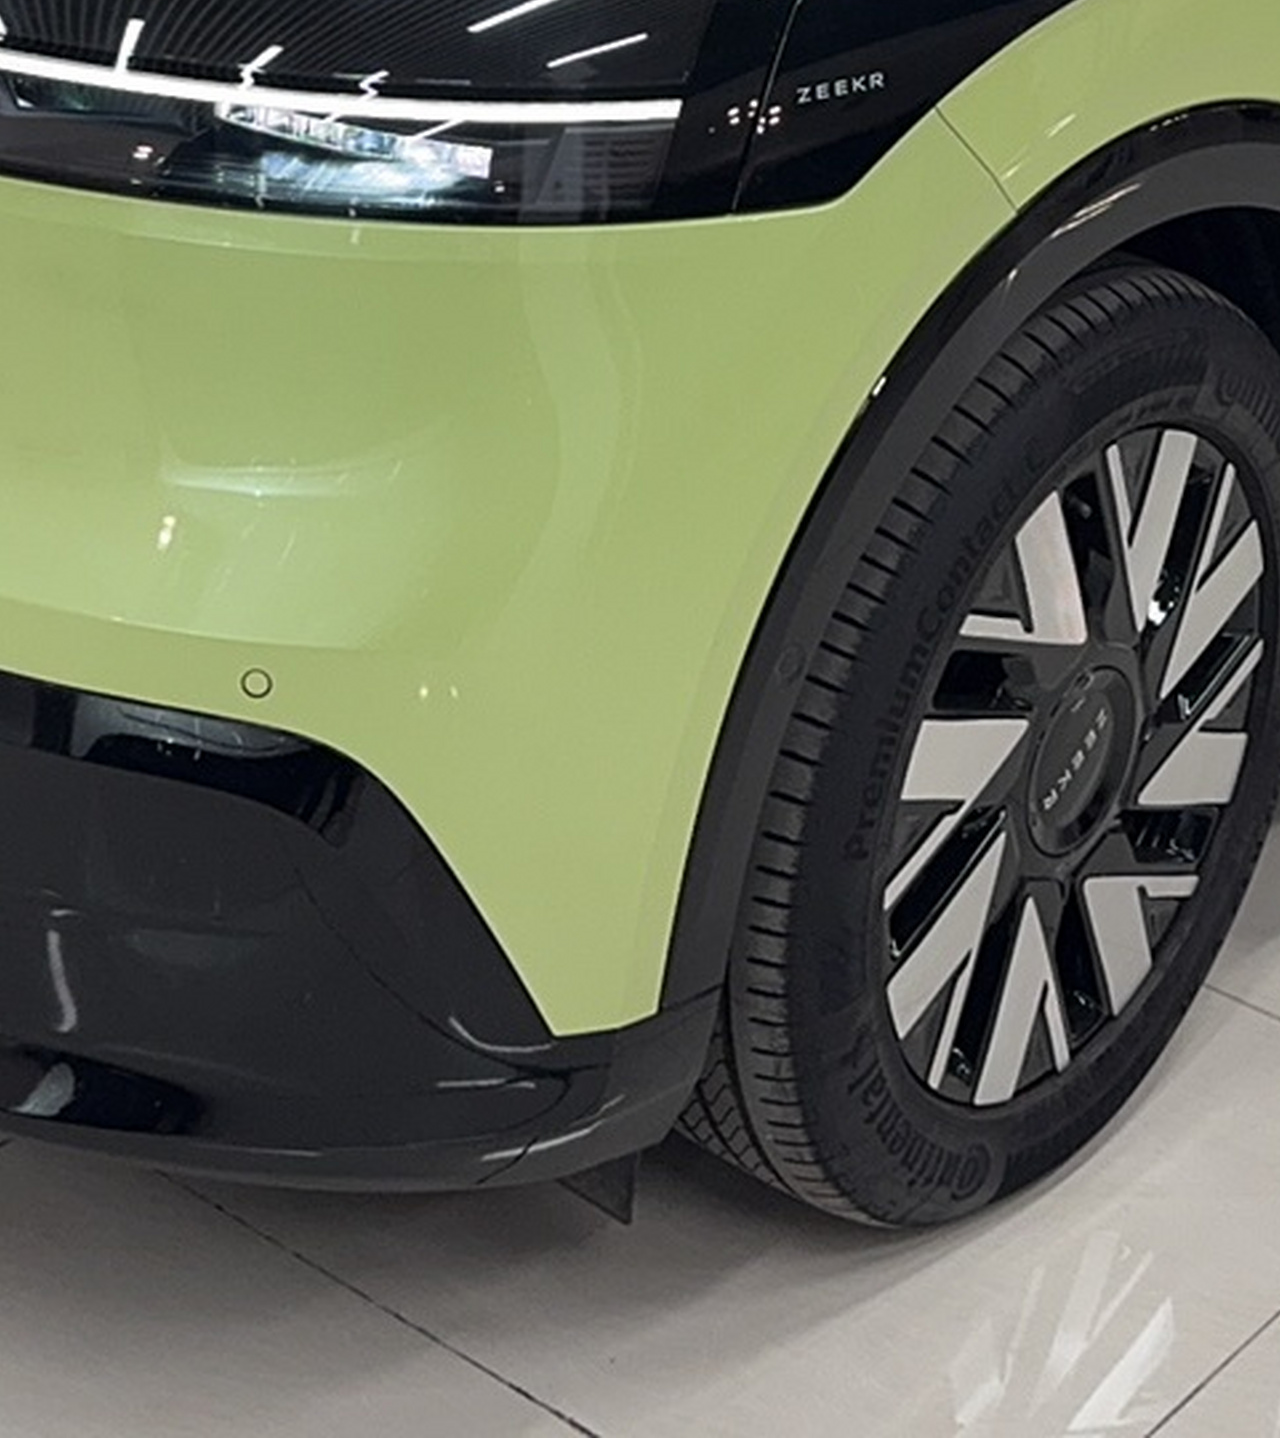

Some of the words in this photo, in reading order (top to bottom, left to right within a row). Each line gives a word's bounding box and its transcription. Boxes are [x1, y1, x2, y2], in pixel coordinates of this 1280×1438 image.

[796, 71, 886, 105] ZEEKR
[843, 476, 1014, 862] PremiumContact
[1042, 706, 1109, 812] ZEEKR
[846, 1058, 992, 1202] Continental
